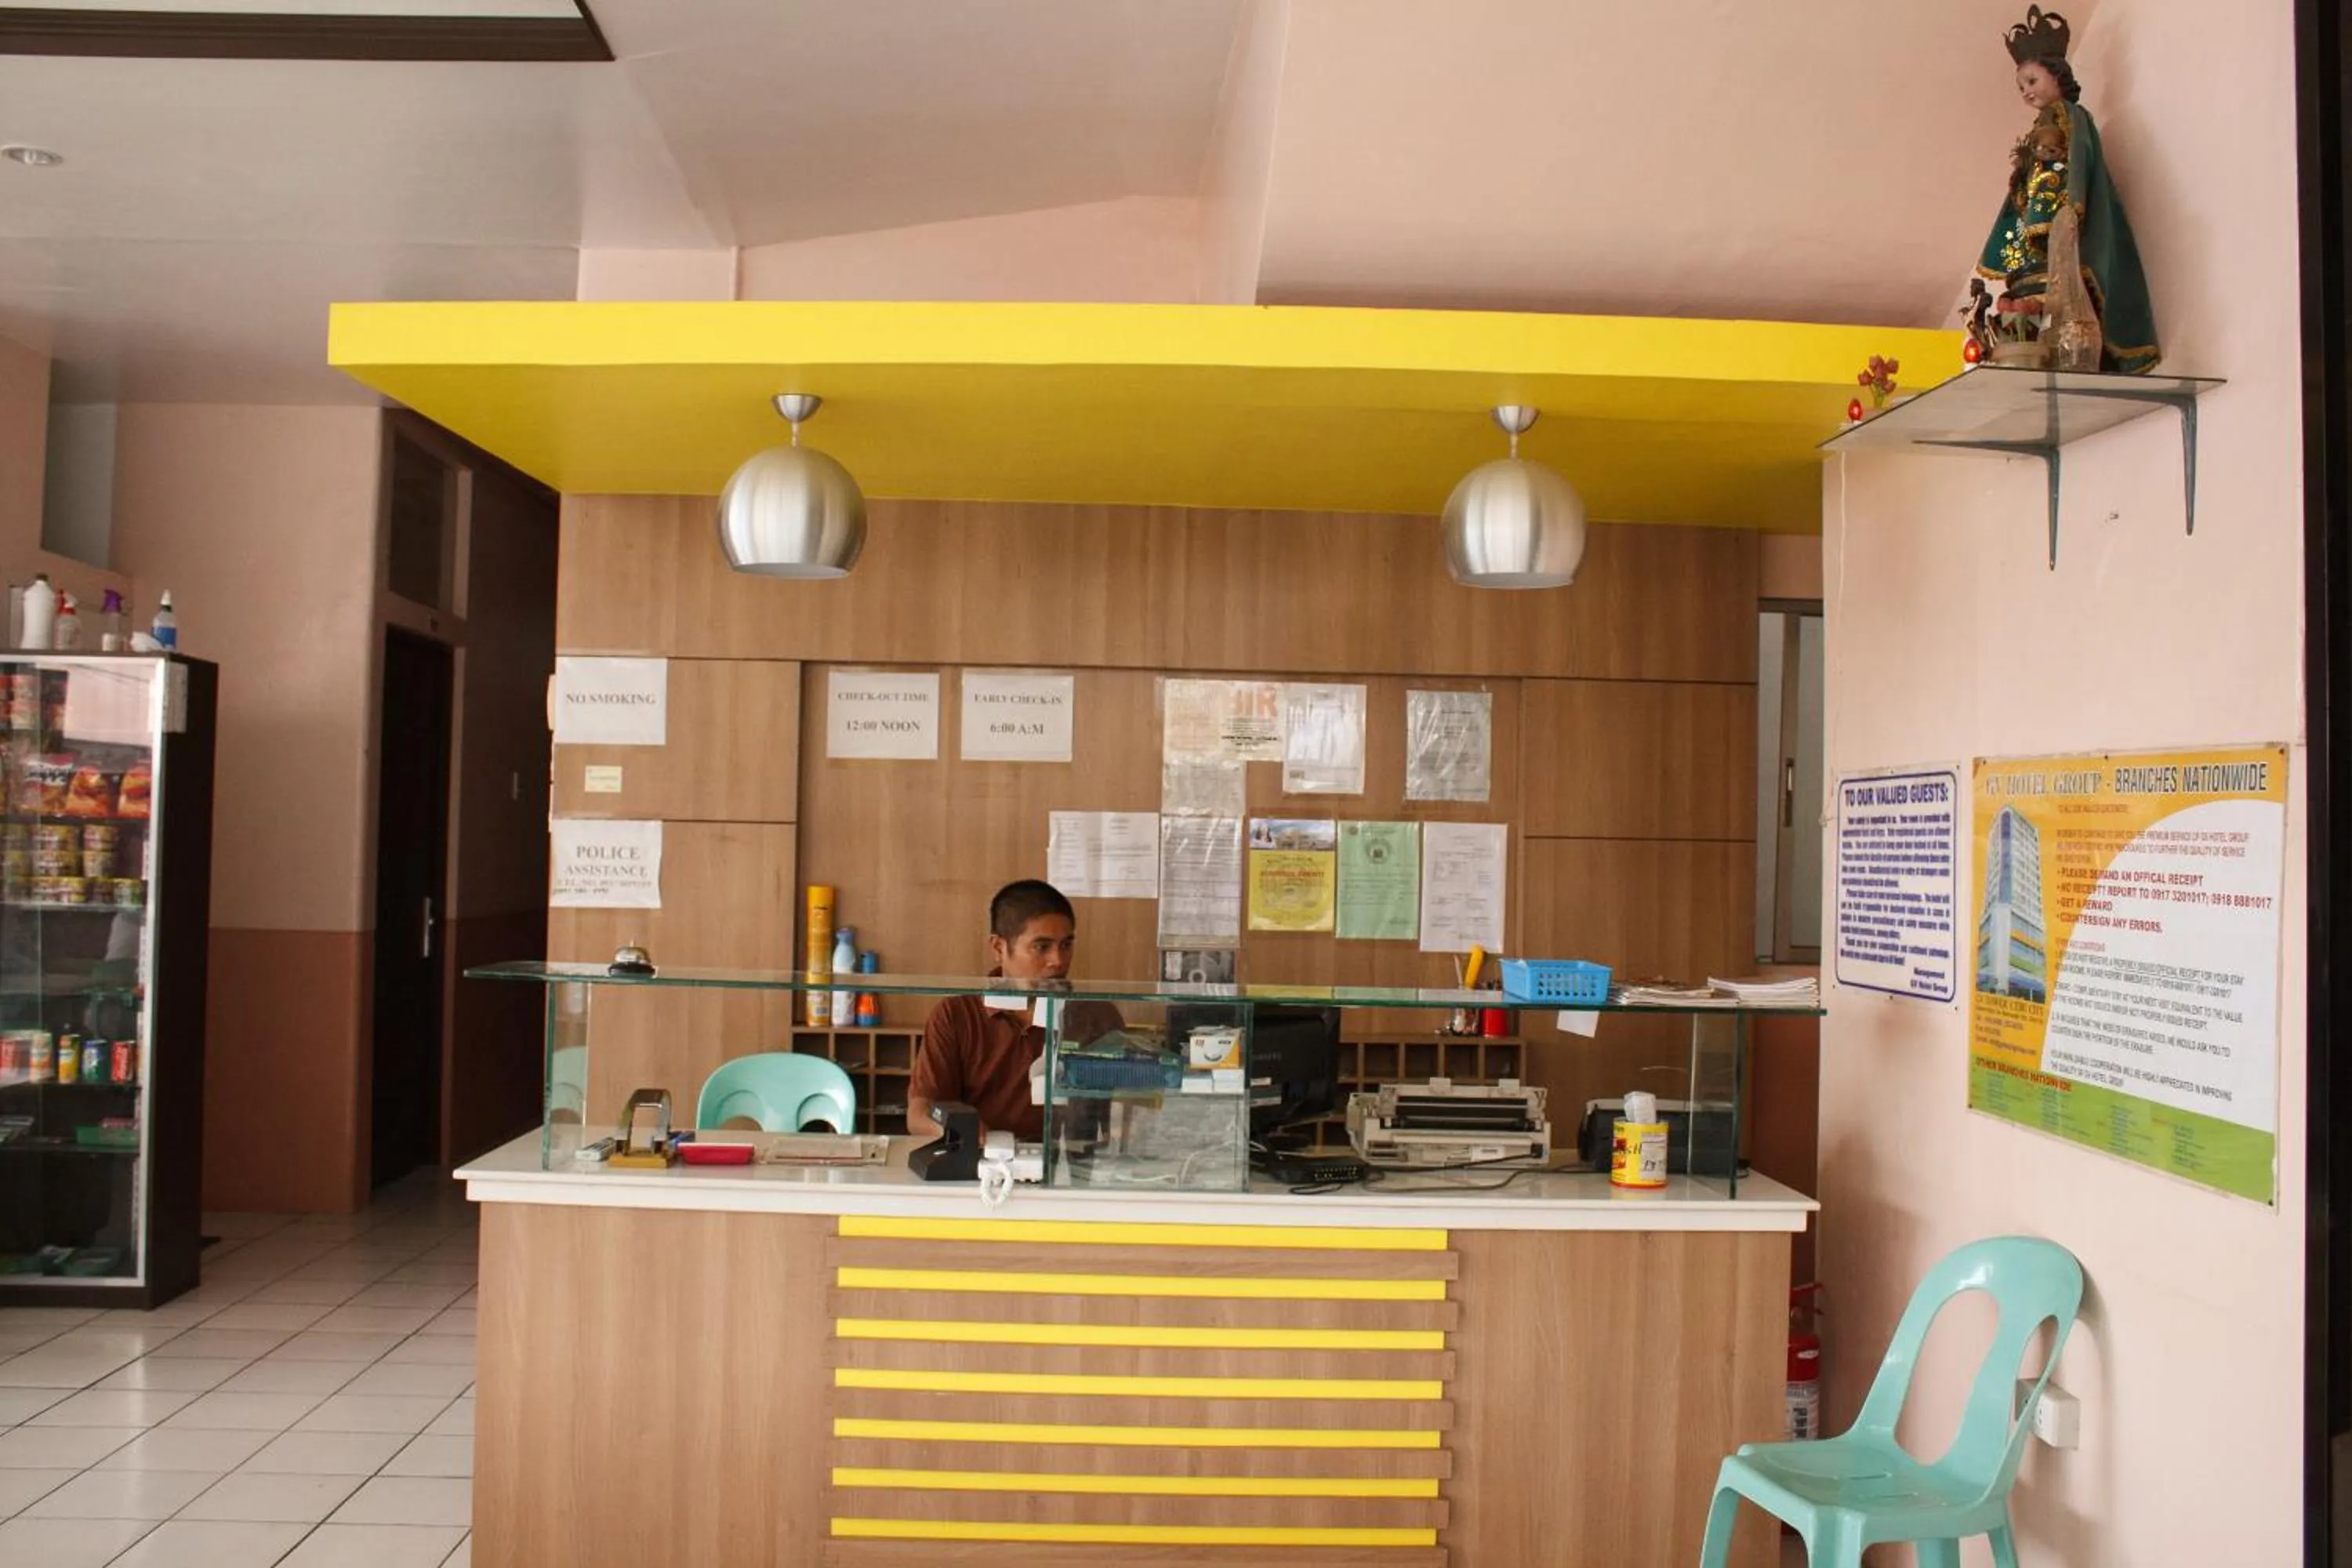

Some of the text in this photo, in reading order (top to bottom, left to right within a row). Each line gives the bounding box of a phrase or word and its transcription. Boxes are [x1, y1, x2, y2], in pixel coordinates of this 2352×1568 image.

[566, 693, 656, 704] NO SMOKING
[838, 692, 928, 702] CHECK-OUT TIME
[975, 694, 1062, 705] EARLY CHECK-IN
[847, 720, 921, 731] 12:00 NOON
[990, 724, 1015, 734] 6:00
[2006, 773, 2045, 794] HOTEL
[2053, 772, 2102, 793] GROUP
[2114, 766, 2177, 793] BRANCHES
[2183, 763, 2267, 793] NATIONWIDE
[1846, 782, 1949, 806] TO OUR VALUED GUESTS:
[576, 845, 641, 860] POLICE
[565, 865, 648, 878] ASSISTANCE
[2060, 867, 2087, 878] PLEASE
[2089, 869, 2118, 880] DEMAND
[2169, 873, 2203, 886] RECEIPT
[2061, 883, 2071, 892] NO
[2107, 886, 2136, 897] REPORT
[2139, 887, 2149, 899] TO
[2151, 888, 2170, 901] 0917
[2061, 898, 2074, 907] GET
[2082, 900, 2112, 911] REWARD
[2060, 913, 2163, 934] COUNTERSIGN ANY ERRORS.
[2214, 972, 2228, 983] YOUR
